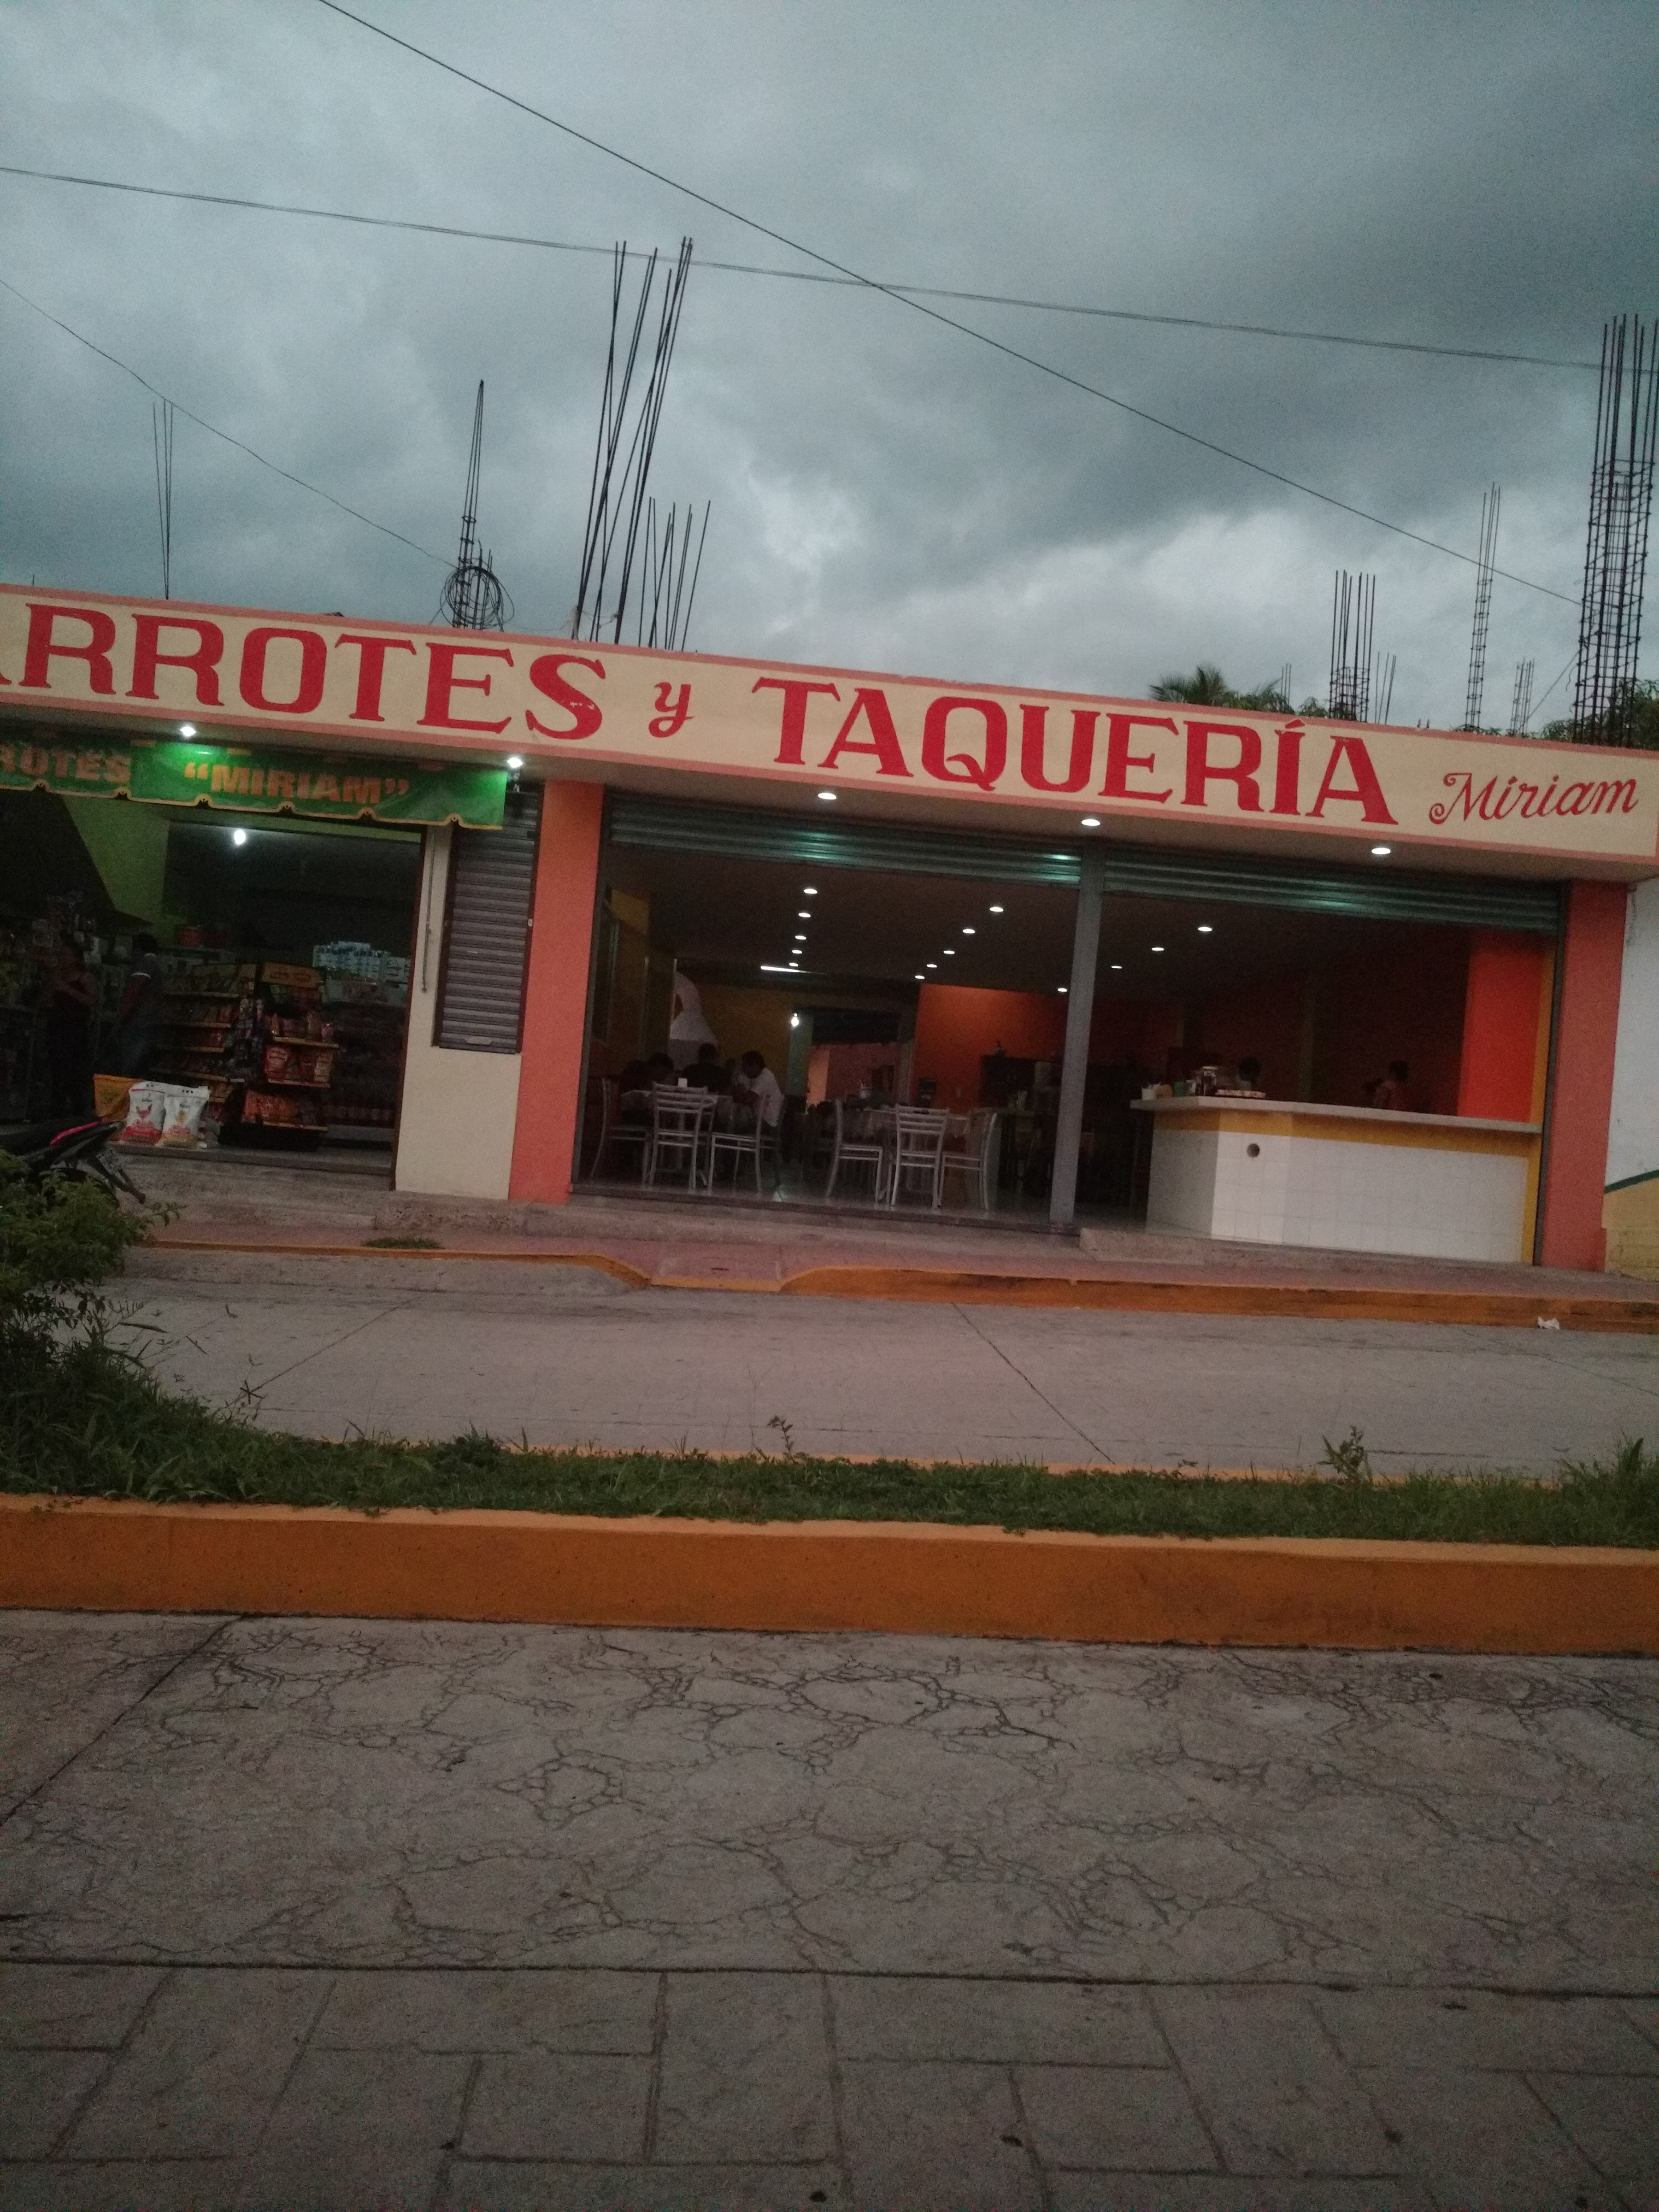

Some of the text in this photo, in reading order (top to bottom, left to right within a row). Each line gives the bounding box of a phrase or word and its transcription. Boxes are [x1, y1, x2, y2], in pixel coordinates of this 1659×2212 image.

[0, 602, 1639, 825] RROTES y TAQUERÍA Miriam
